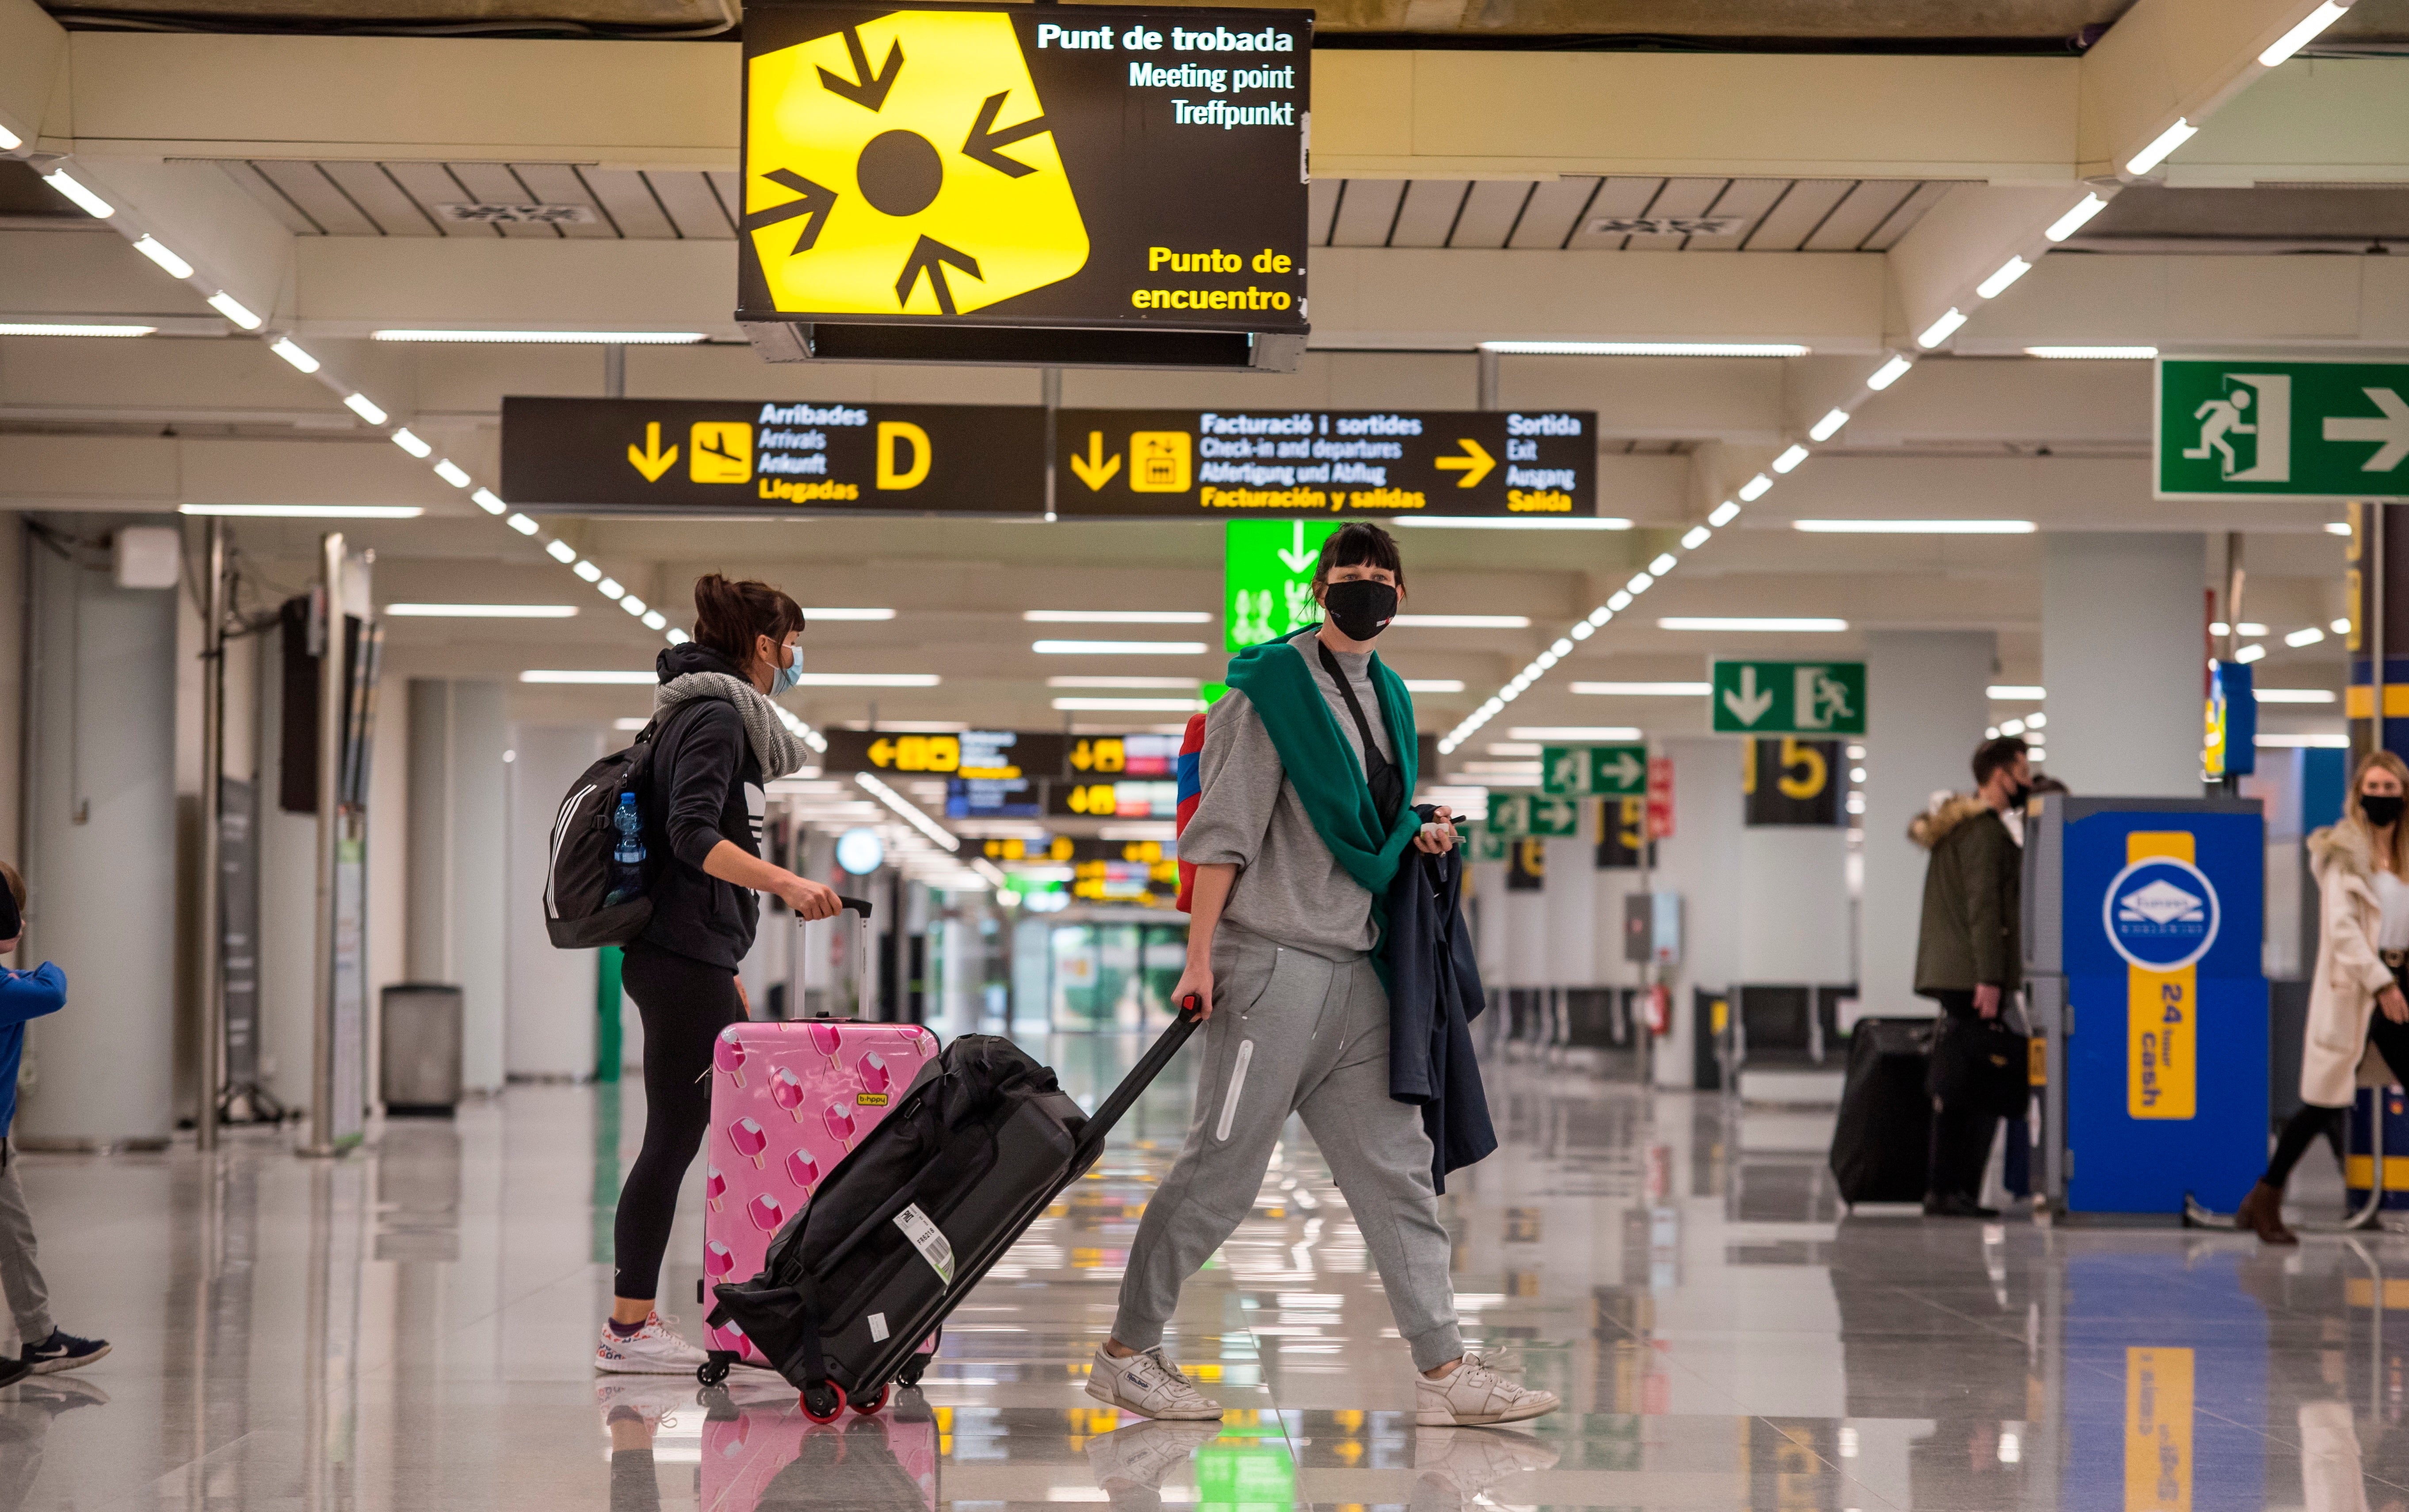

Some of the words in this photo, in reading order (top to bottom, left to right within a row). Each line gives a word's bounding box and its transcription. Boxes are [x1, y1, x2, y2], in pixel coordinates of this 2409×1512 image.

[1038, 24, 1114, 50] Punt
[1123, 26, 1162, 50] de
[1171, 27, 1293, 51] trobada
[1130, 62, 1227, 92] Meeting
[1233, 65, 1294, 92] point
[1171, 100, 1294, 129] Treffpunkt
[1149, 247, 1242, 272] Punto
[1252, 249, 1291, 273] de
[1132, 286, 1290, 310] encuentro
[759, 404, 867, 425] Arribades
[1201, 414, 1313, 434] Facturació
[1320, 415, 1328, 434] i
[1337, 415, 1422, 435] sortides
[1508, 414, 1581, 435] Sortida
[759, 428, 826, 449] Arrivals
[1200, 437, 1274, 457] Check-in
[1277, 439, 1309, 458] and
[1312, 439, 1402, 460] departures
[1508, 439, 1537, 460] Exit
[758, 453, 826, 474] Ankunft
[877, 422, 931, 490] D
[1199, 462, 1295, 486] Abfertigung
[1297, 464, 1329, 482] und
[1332, 463, 1386, 486] Abflug
[1507, 465, 1575, 490] Ausgang
[759, 479, 858, 503] Llegadas
[1201, 487, 1325, 507] Facturación
[1331, 492, 1345, 511] y
[1350, 488, 1425, 508] salidas
[1508, 490, 1571, 511] Salida
[2161, 983, 2183, 1025] 24
[2142, 1031, 2162, 1107] cash
[1127, 1373, 1149, 1388] Reebok
